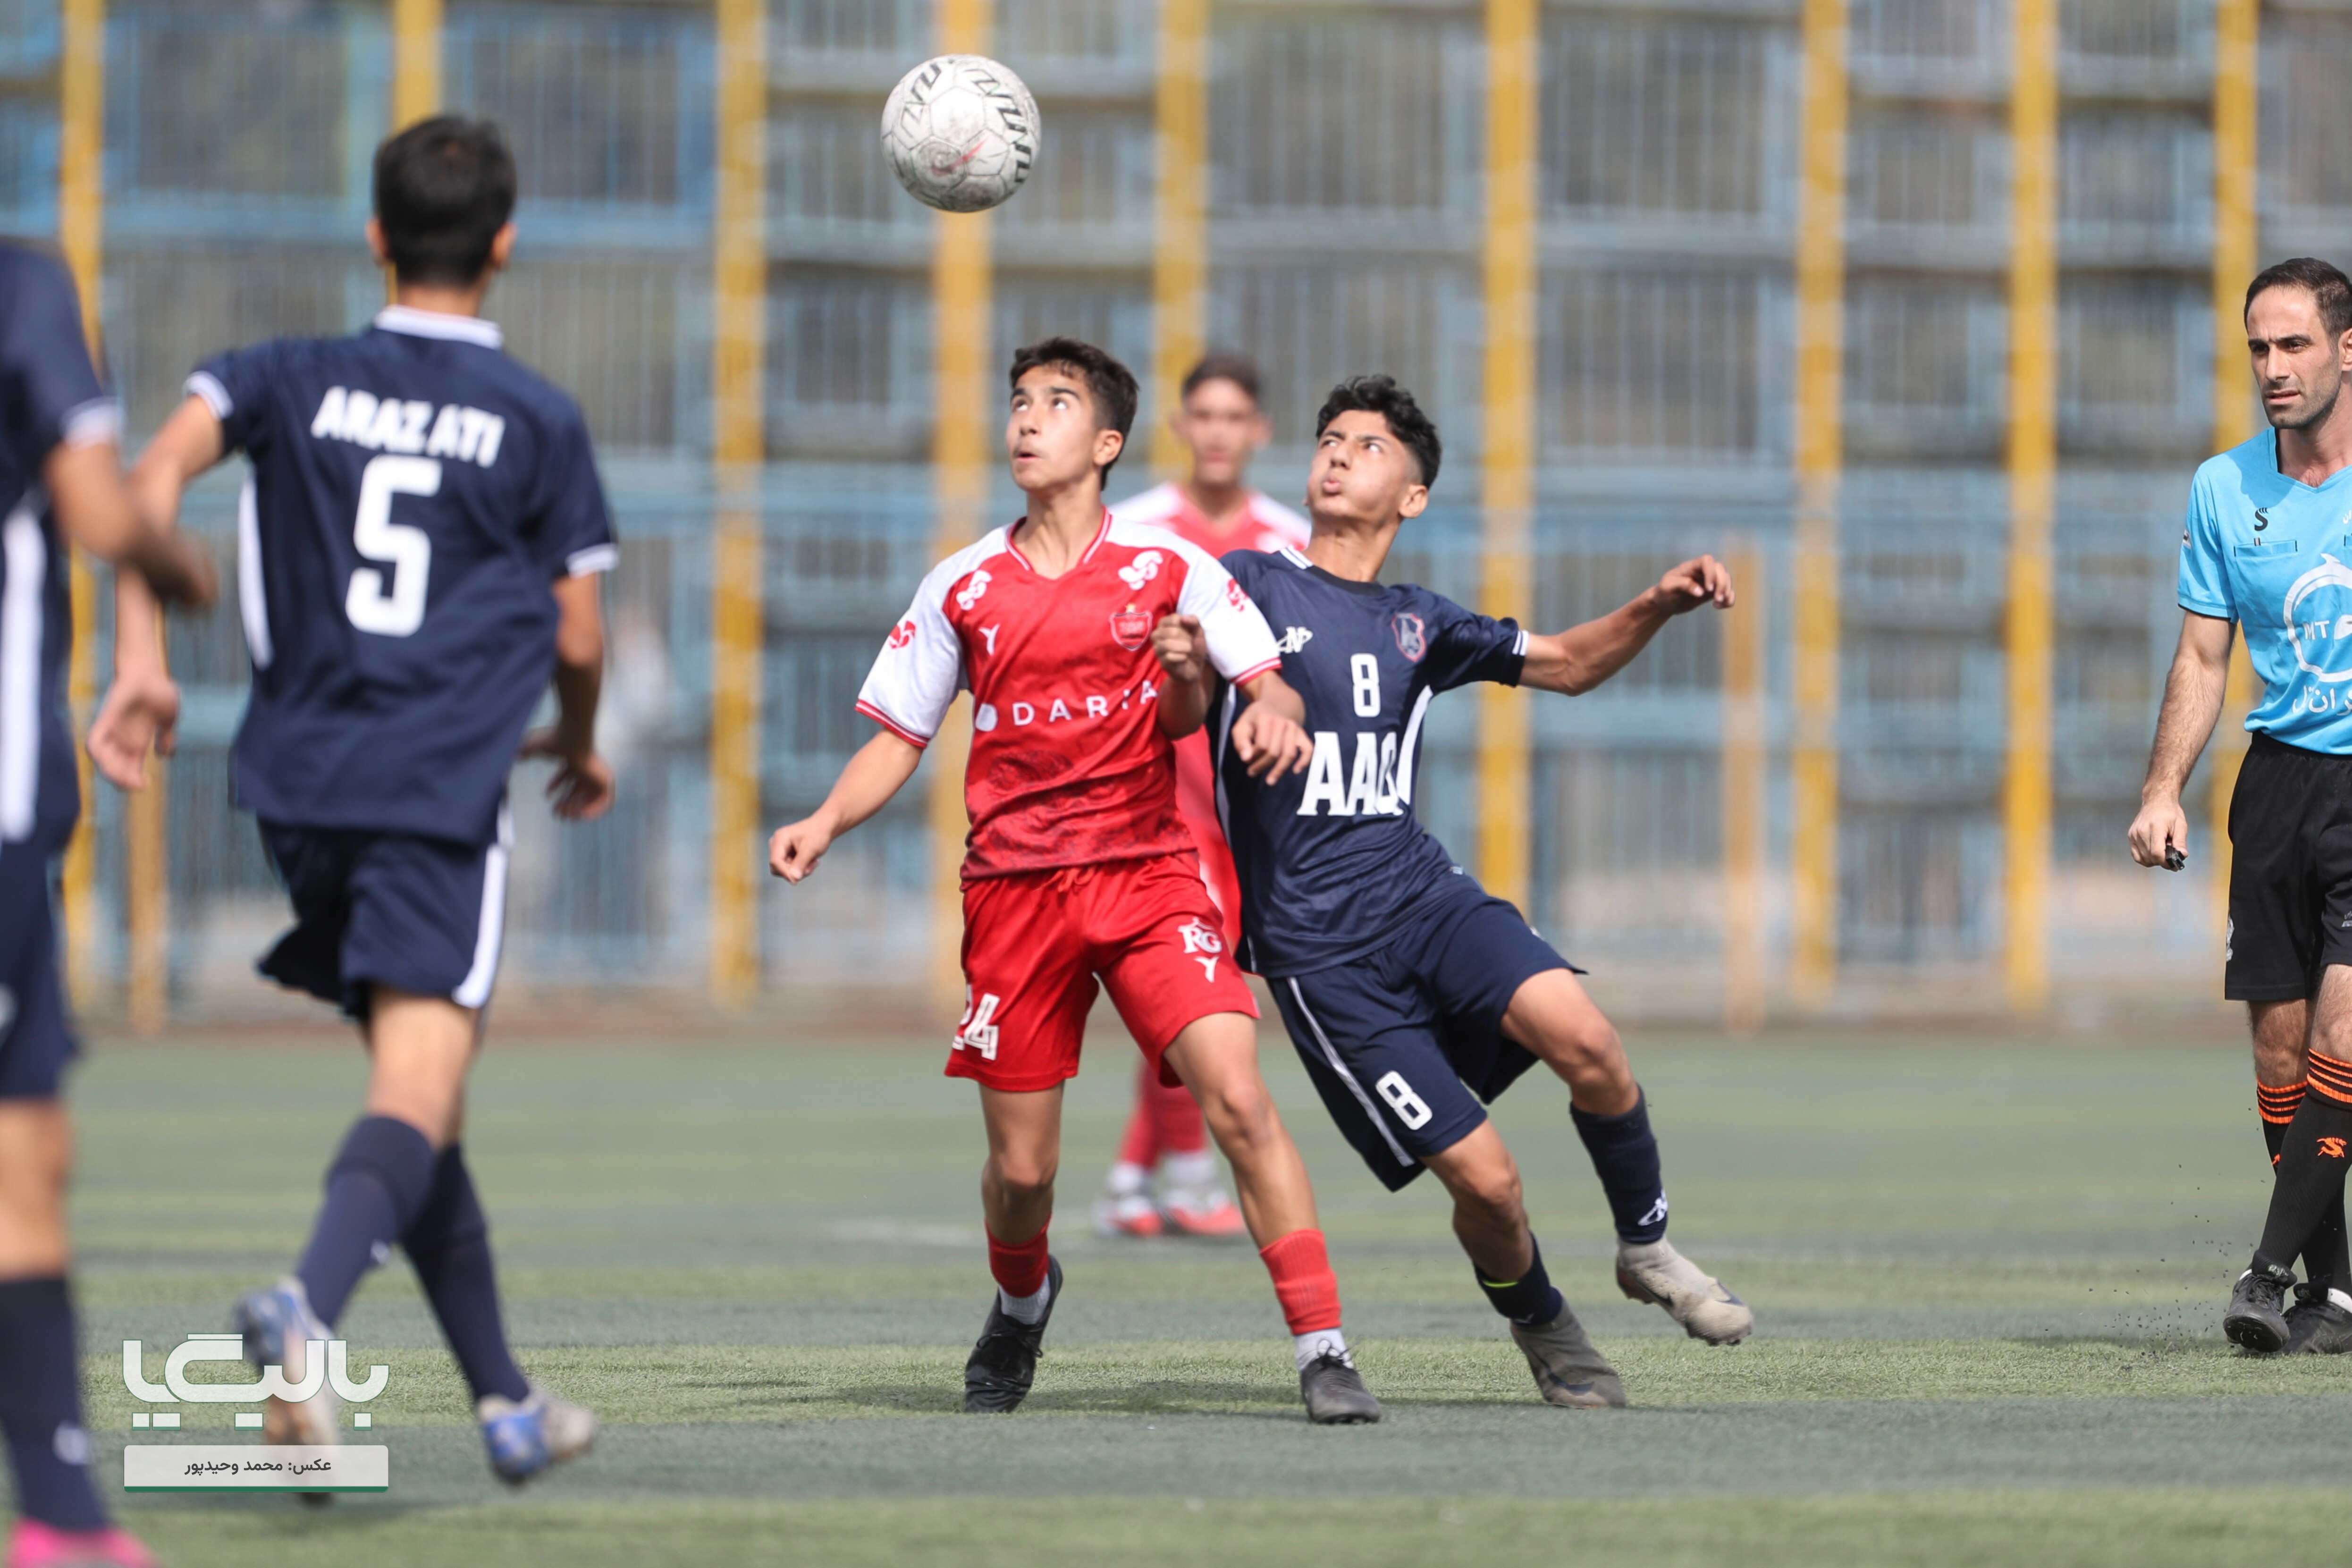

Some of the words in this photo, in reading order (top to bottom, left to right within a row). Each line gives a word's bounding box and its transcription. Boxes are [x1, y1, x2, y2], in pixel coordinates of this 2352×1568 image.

[346, 454, 443, 637] 5
[2302, 621, 2330, 640] MT
[1350, 653, 1381, 717] 8
[1177, 919, 1223, 953] RG
[1375, 1070, 1433, 1130] 8
